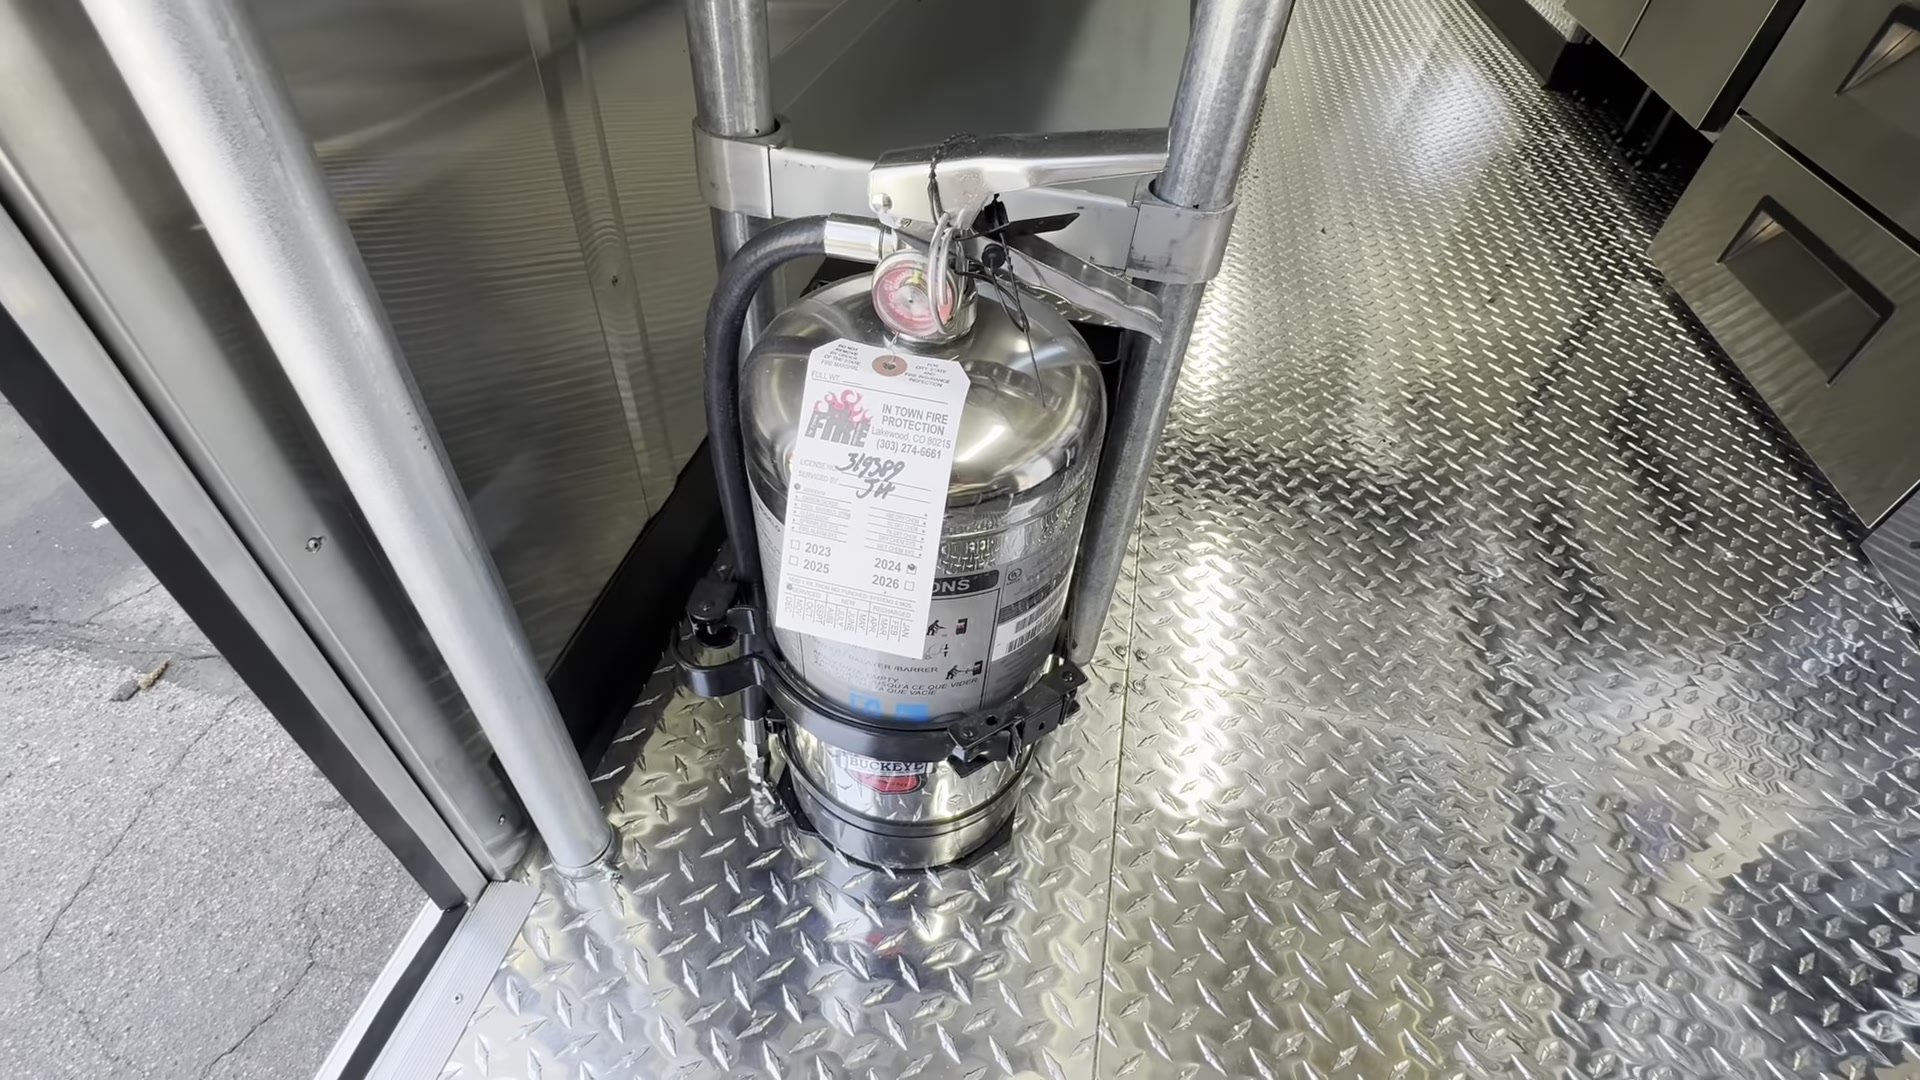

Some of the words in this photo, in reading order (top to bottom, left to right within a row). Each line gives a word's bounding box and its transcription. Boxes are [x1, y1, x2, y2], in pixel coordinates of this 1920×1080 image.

[811, 370, 828, 379] FULL
[882, 403, 892, 415] IN
[894, 405, 924, 420] TOWN
[925, 411, 949, 425] FIRE
[881, 415, 945, 436] PROTECTION
[871, 426, 911, 442] Lakewood,
[912, 433, 926, 444] CO
[927, 436, 952, 449] 80215
[876, 438, 899, 454] (303)
[900, 443, 942, 460] 274-6661
[799, 458, 825, 469] LICENSE
[798, 470, 829, 482] SERVICED
[804, 542, 832, 558] 2023
[803, 559, 831, 574] 2025
[873, 557, 902, 573] 2024
[871, 574, 901, 590] 2026
[783, 596, 794, 613] DEC
[794, 599, 804, 617] NOV
[805, 601, 815, 617] OCT
[841, 598, 855, 606] NEW
[814, 604, 826, 624] SEPT
[825, 606, 836, 624] AUG
[835, 609, 846, 628] JULY
[872, 605, 911, 618] RECHARGED
[845, 611, 857, 632] JUNE
[857, 613, 868, 631] MAY
[868, 616, 878, 633] APR
[879, 617, 890, 636] MAR
[890, 620, 900, 636] FEB
[901, 622, 911, 638] JAN
[927, 682, 948, 691] QUE
[950, 677, 978, 689] VIDER
[849, 756, 925, 772] BUCKEYE
